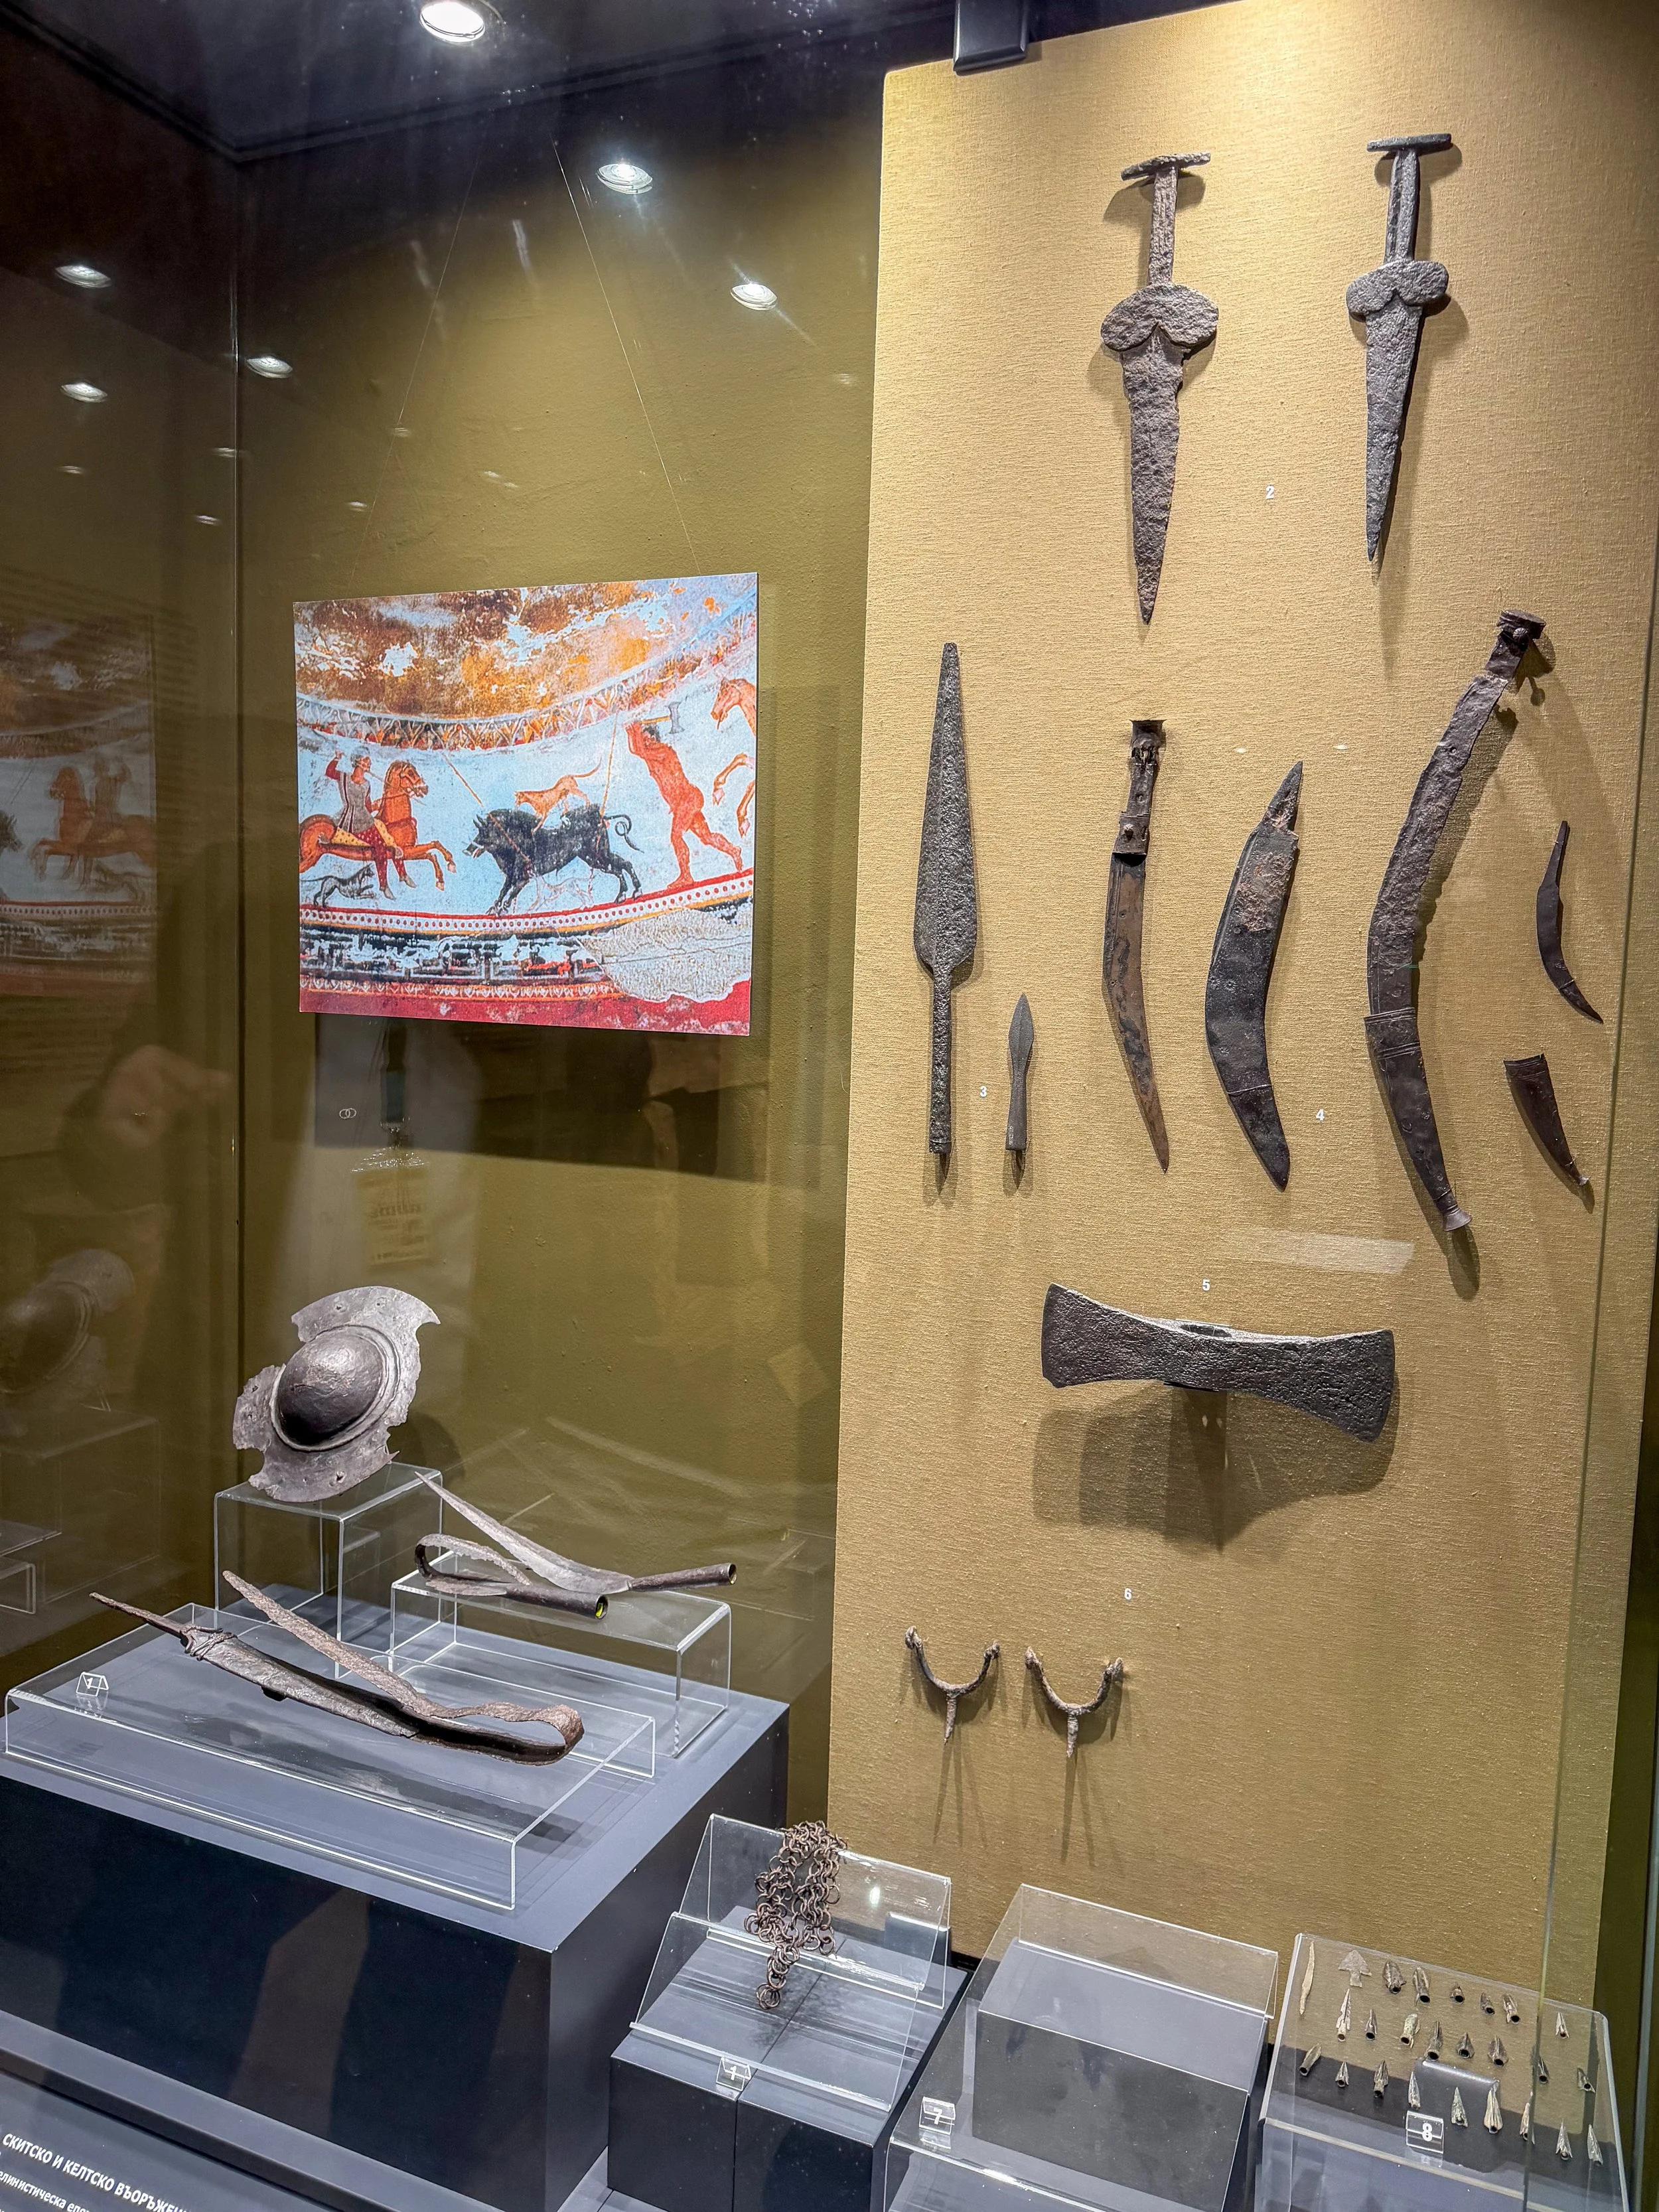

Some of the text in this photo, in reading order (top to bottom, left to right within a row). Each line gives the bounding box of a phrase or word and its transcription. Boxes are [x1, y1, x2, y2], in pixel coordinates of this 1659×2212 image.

[1265, 484, 1275, 499] 2
[979, 1085, 987, 1097] 3
[1315, 1109, 1325, 1121] 4
[1202, 1279, 1210, 1291] 5
[1124, 1587, 1132, 1599] 6
[87, 1677, 93, 1689] 1
[730, 2065, 737, 2081] 1
[933, 2107, 942, 2124] 7
[1422, 2122, 1432, 2142] 8
[3, 2134, 187, 2212] СКИТСКО И КЕЛТСКО ВЪОРЪЖЕ
